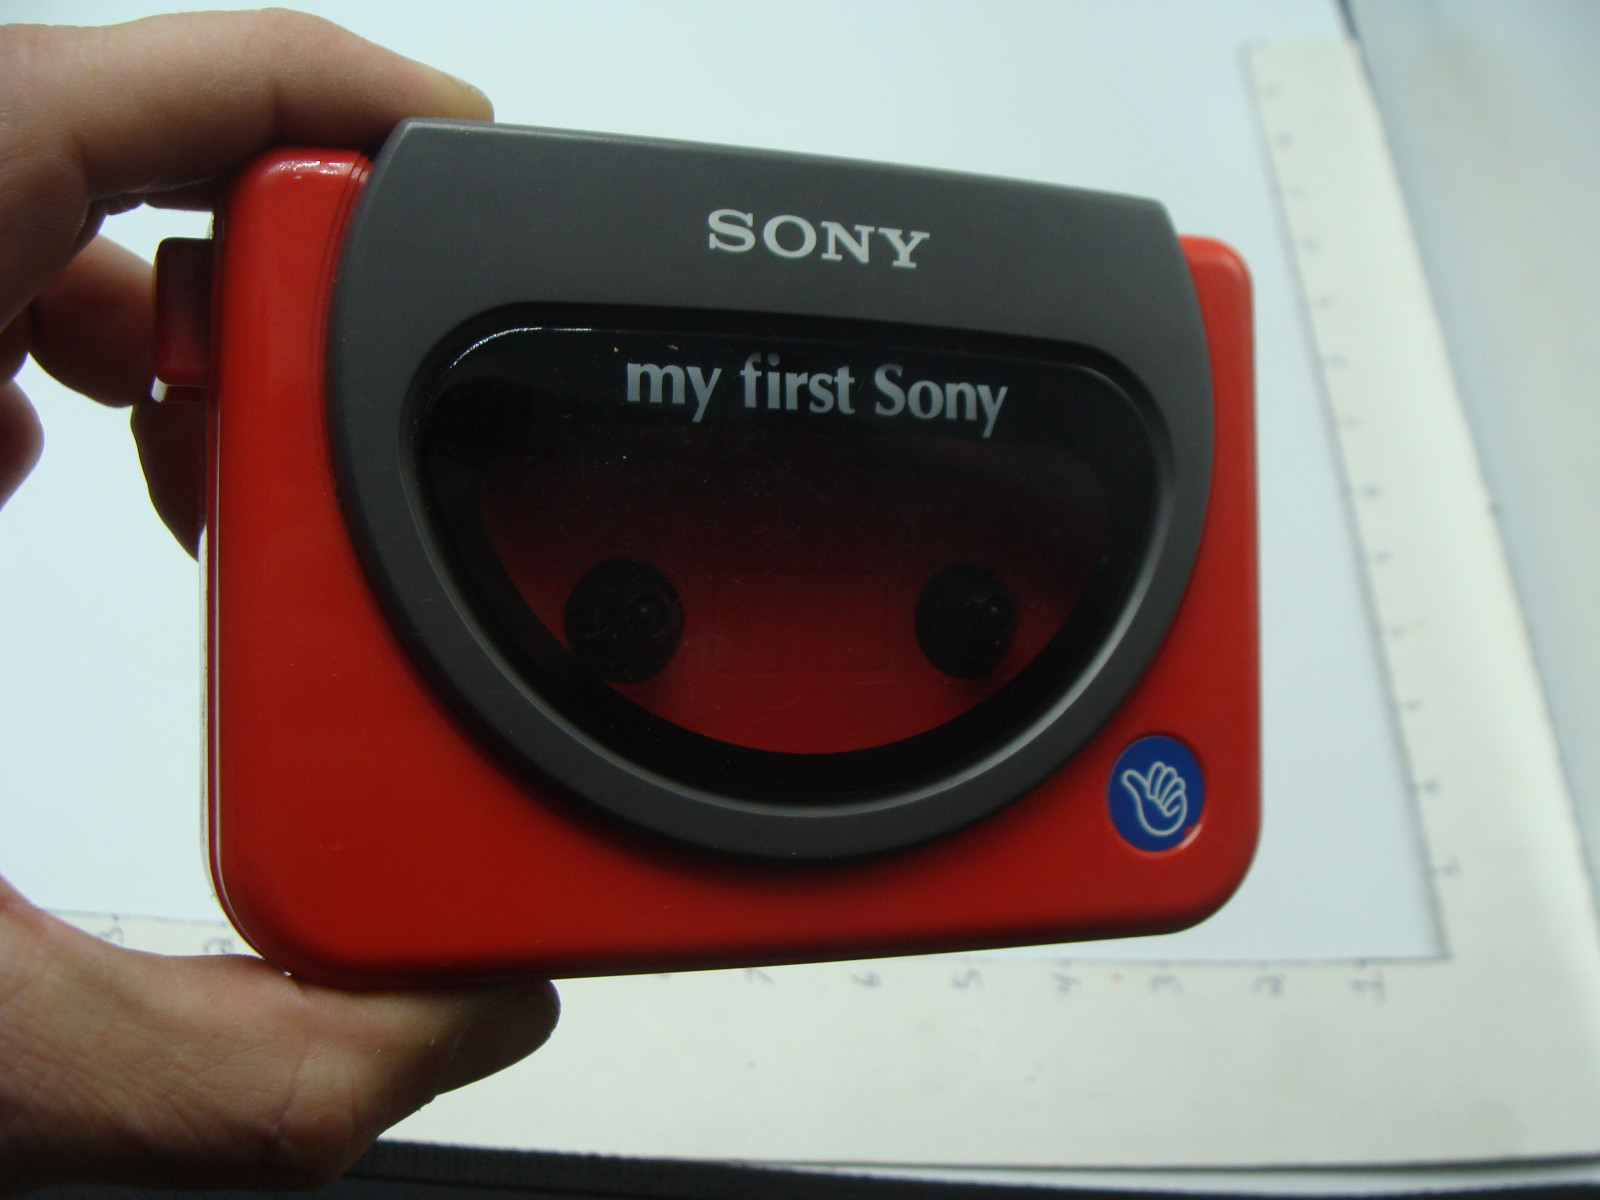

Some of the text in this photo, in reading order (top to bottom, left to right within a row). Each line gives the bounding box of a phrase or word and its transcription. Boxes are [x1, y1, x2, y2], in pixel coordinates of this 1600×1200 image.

[708, 208, 931, 269] SONY
[626, 352, 1009, 439] my first Sony
